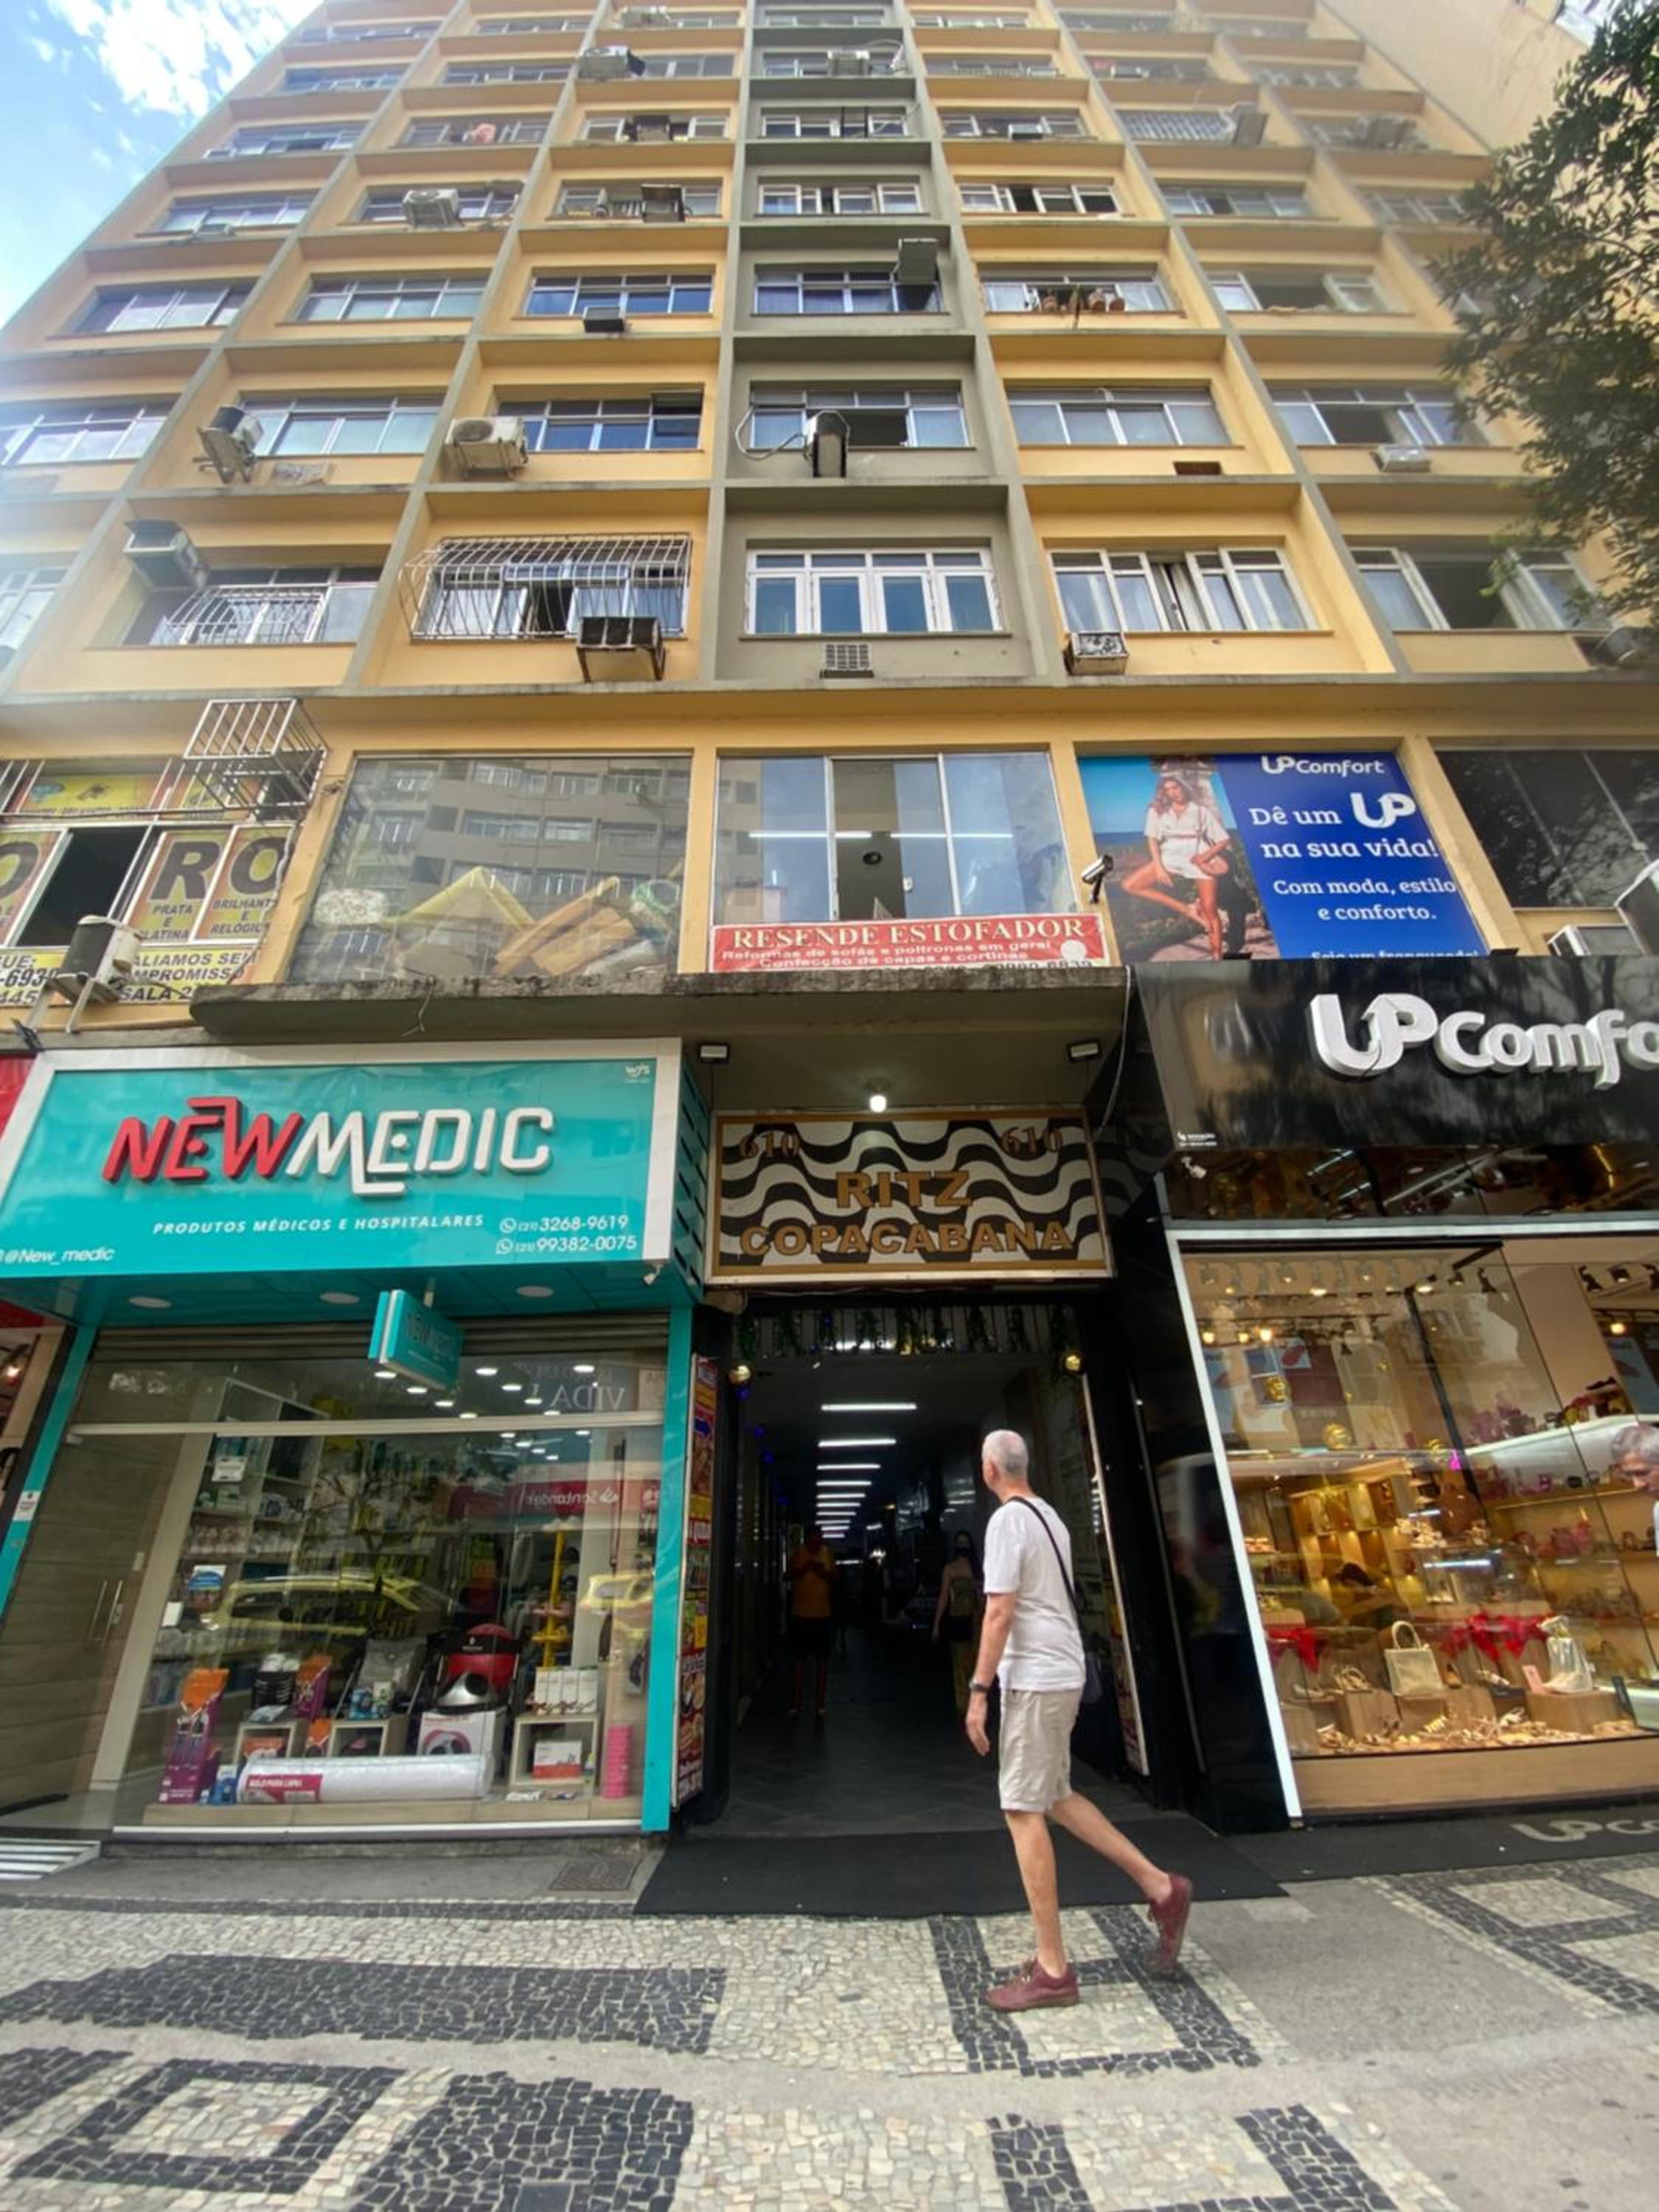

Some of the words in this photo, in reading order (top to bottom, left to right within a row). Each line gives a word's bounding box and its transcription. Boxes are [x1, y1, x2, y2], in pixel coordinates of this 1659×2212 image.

[1249, 806, 1288, 825] Dê
[1293, 810, 1342, 824] um
[1350, 792, 1416, 829] UP
[1261, 843, 1301, 858] na
[1307, 841, 1361, 858] sua
[1364, 838, 1439, 858] vida!
[1273, 880, 1324, 894] Com
[1326, 877, 1396, 896] moda,
[1399, 877, 1457, 894] estilo
[153, 905, 192, 914] PRATA
[241, 911, 249, 921] E
[1318, 907, 1330, 920] e
[1335, 904, 1436, 920] conforto.
[163, 917, 173, 927] E
[734, 926, 879, 948] RESENDE
[889, 919, 1085, 945] ESTOFADOR
[723, 950, 801, 961] Reformas
[805, 947, 827, 957] de
[738, 1131, 801, 1158] 610
[1001, 1125, 1064, 1155] 610
[835, 1170, 973, 1208] RITZ
[153, 1222, 246, 1235] PRODUTOS
[253, 1218, 331, 1233] MÉDICOS
[338, 1219, 347, 1230] E
[355, 1214, 484, 1229] HOSPITALARES
[539, 1215, 627, 1232] 3268-9619
[537, 1235, 637, 1252] 99382-0075
[740, 1221, 1074, 1255] COPACABANA
[4, 1246, 115, 1265] @New_medic
